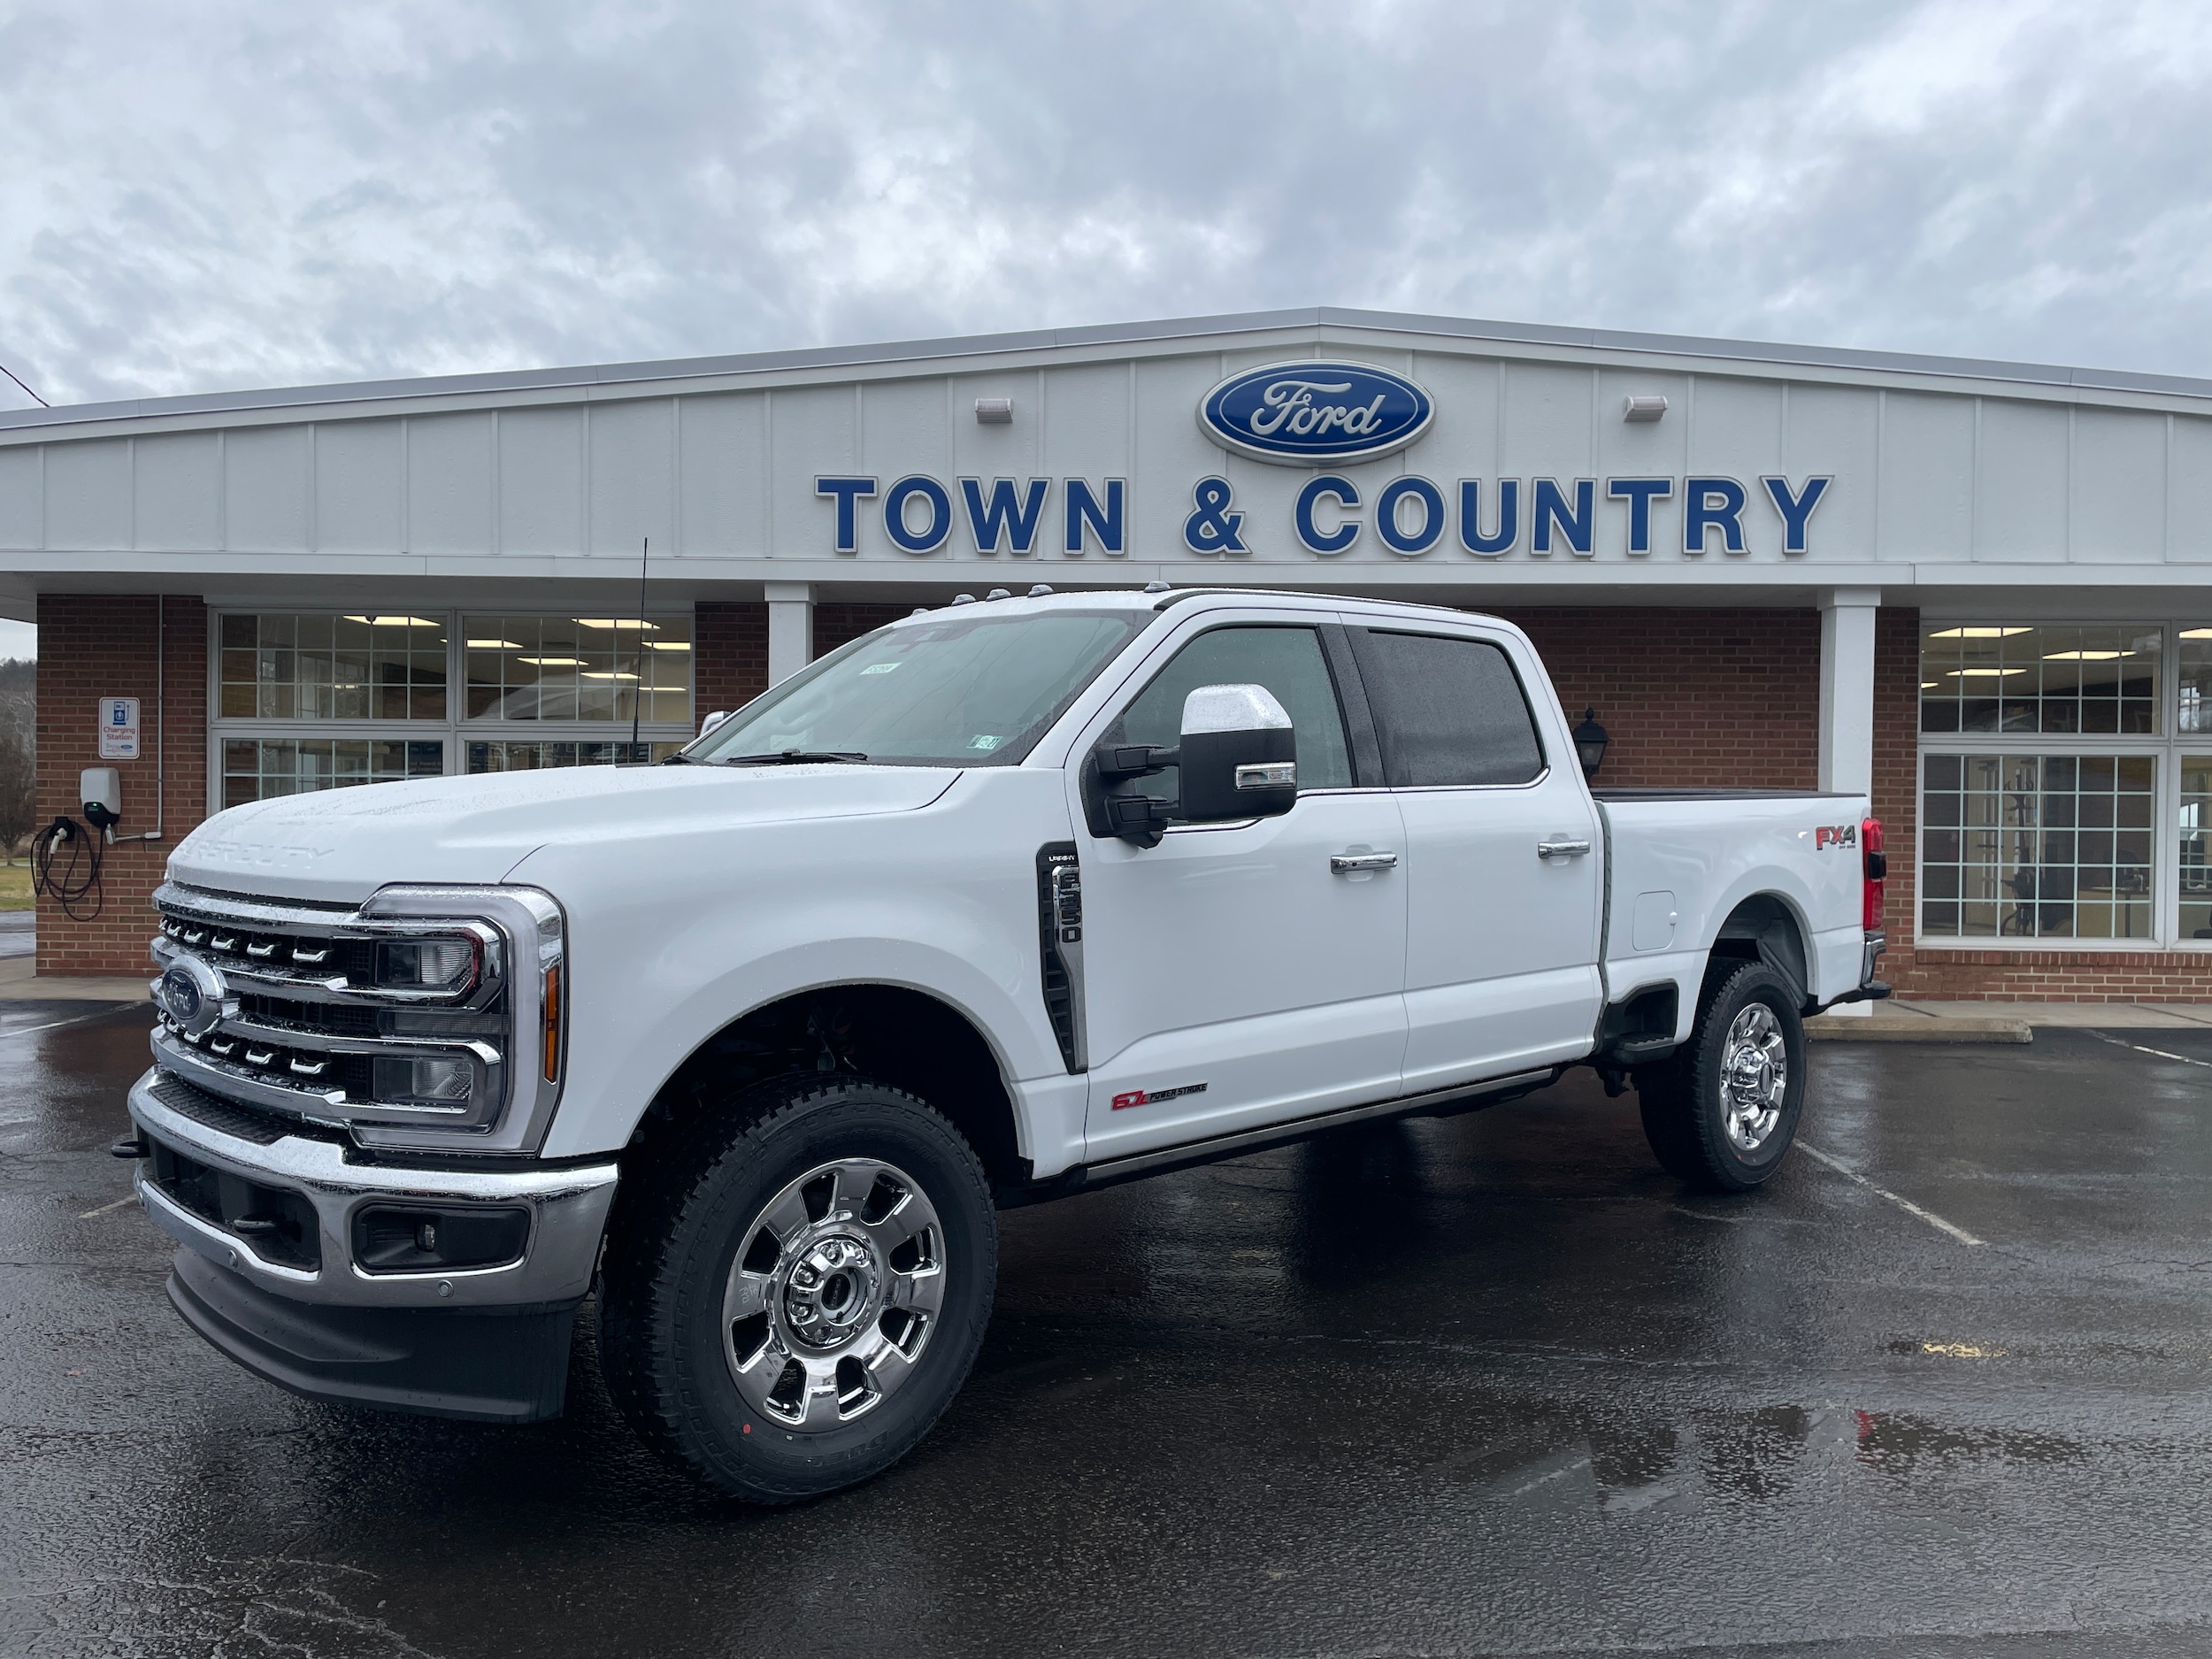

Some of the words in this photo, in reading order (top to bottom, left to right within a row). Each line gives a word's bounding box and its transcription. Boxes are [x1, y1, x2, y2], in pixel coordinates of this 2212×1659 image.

[1249, 380, 1386, 435] Ford
[814, 474, 1127, 555] TOWN
[1183, 475, 1252, 555] &
[1294, 473, 1835, 557] COUNTRY
[1816, 825, 1855, 851] FX4
[1150, 1088, 1177, 1101] POWER
[1177, 1082, 1208, 1096] STROKE
